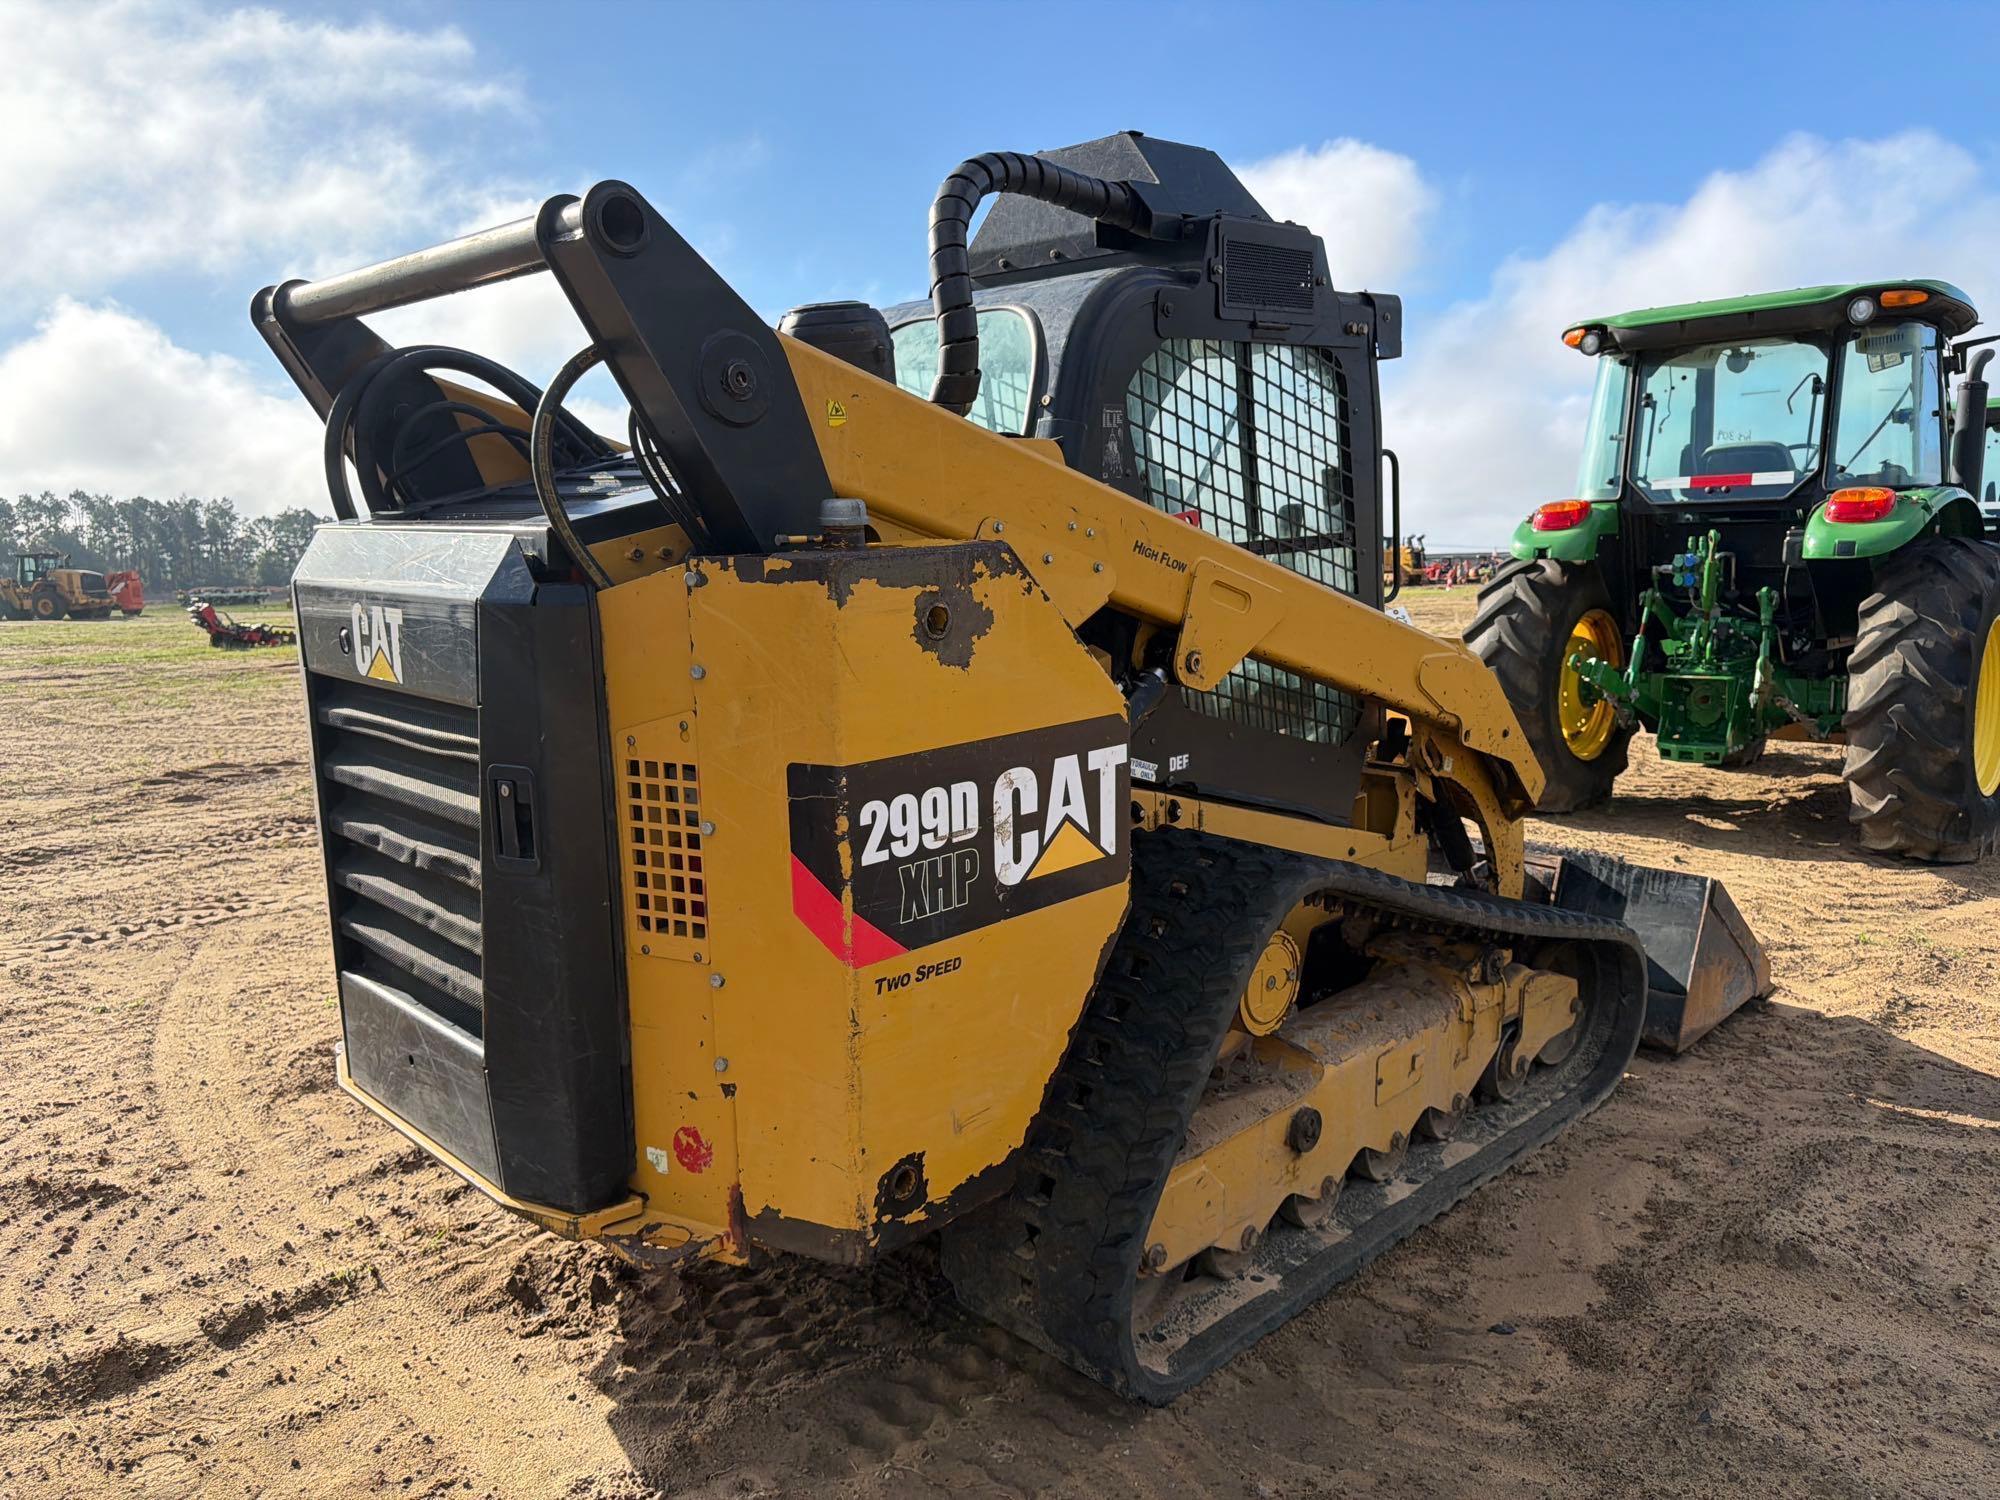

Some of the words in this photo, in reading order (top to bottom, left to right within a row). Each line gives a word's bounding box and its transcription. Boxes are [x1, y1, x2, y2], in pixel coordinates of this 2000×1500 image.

[1133, 540, 1159, 561] HIGH
[1160, 552, 1188, 573] FLOW
[352, 602, 403, 683] CAT
[1131, 760, 1157, 772] YDRAULIC
[1140, 770, 1153, 779] ONLY
[1169, 754, 1189, 772] DEF
[860, 781, 979, 866] 299D
[993, 743, 1127, 886] CAT
[898, 848, 979, 924] XHP
[875, 973, 911, 995] TWO
[915, 957, 962, 983] SPEED
